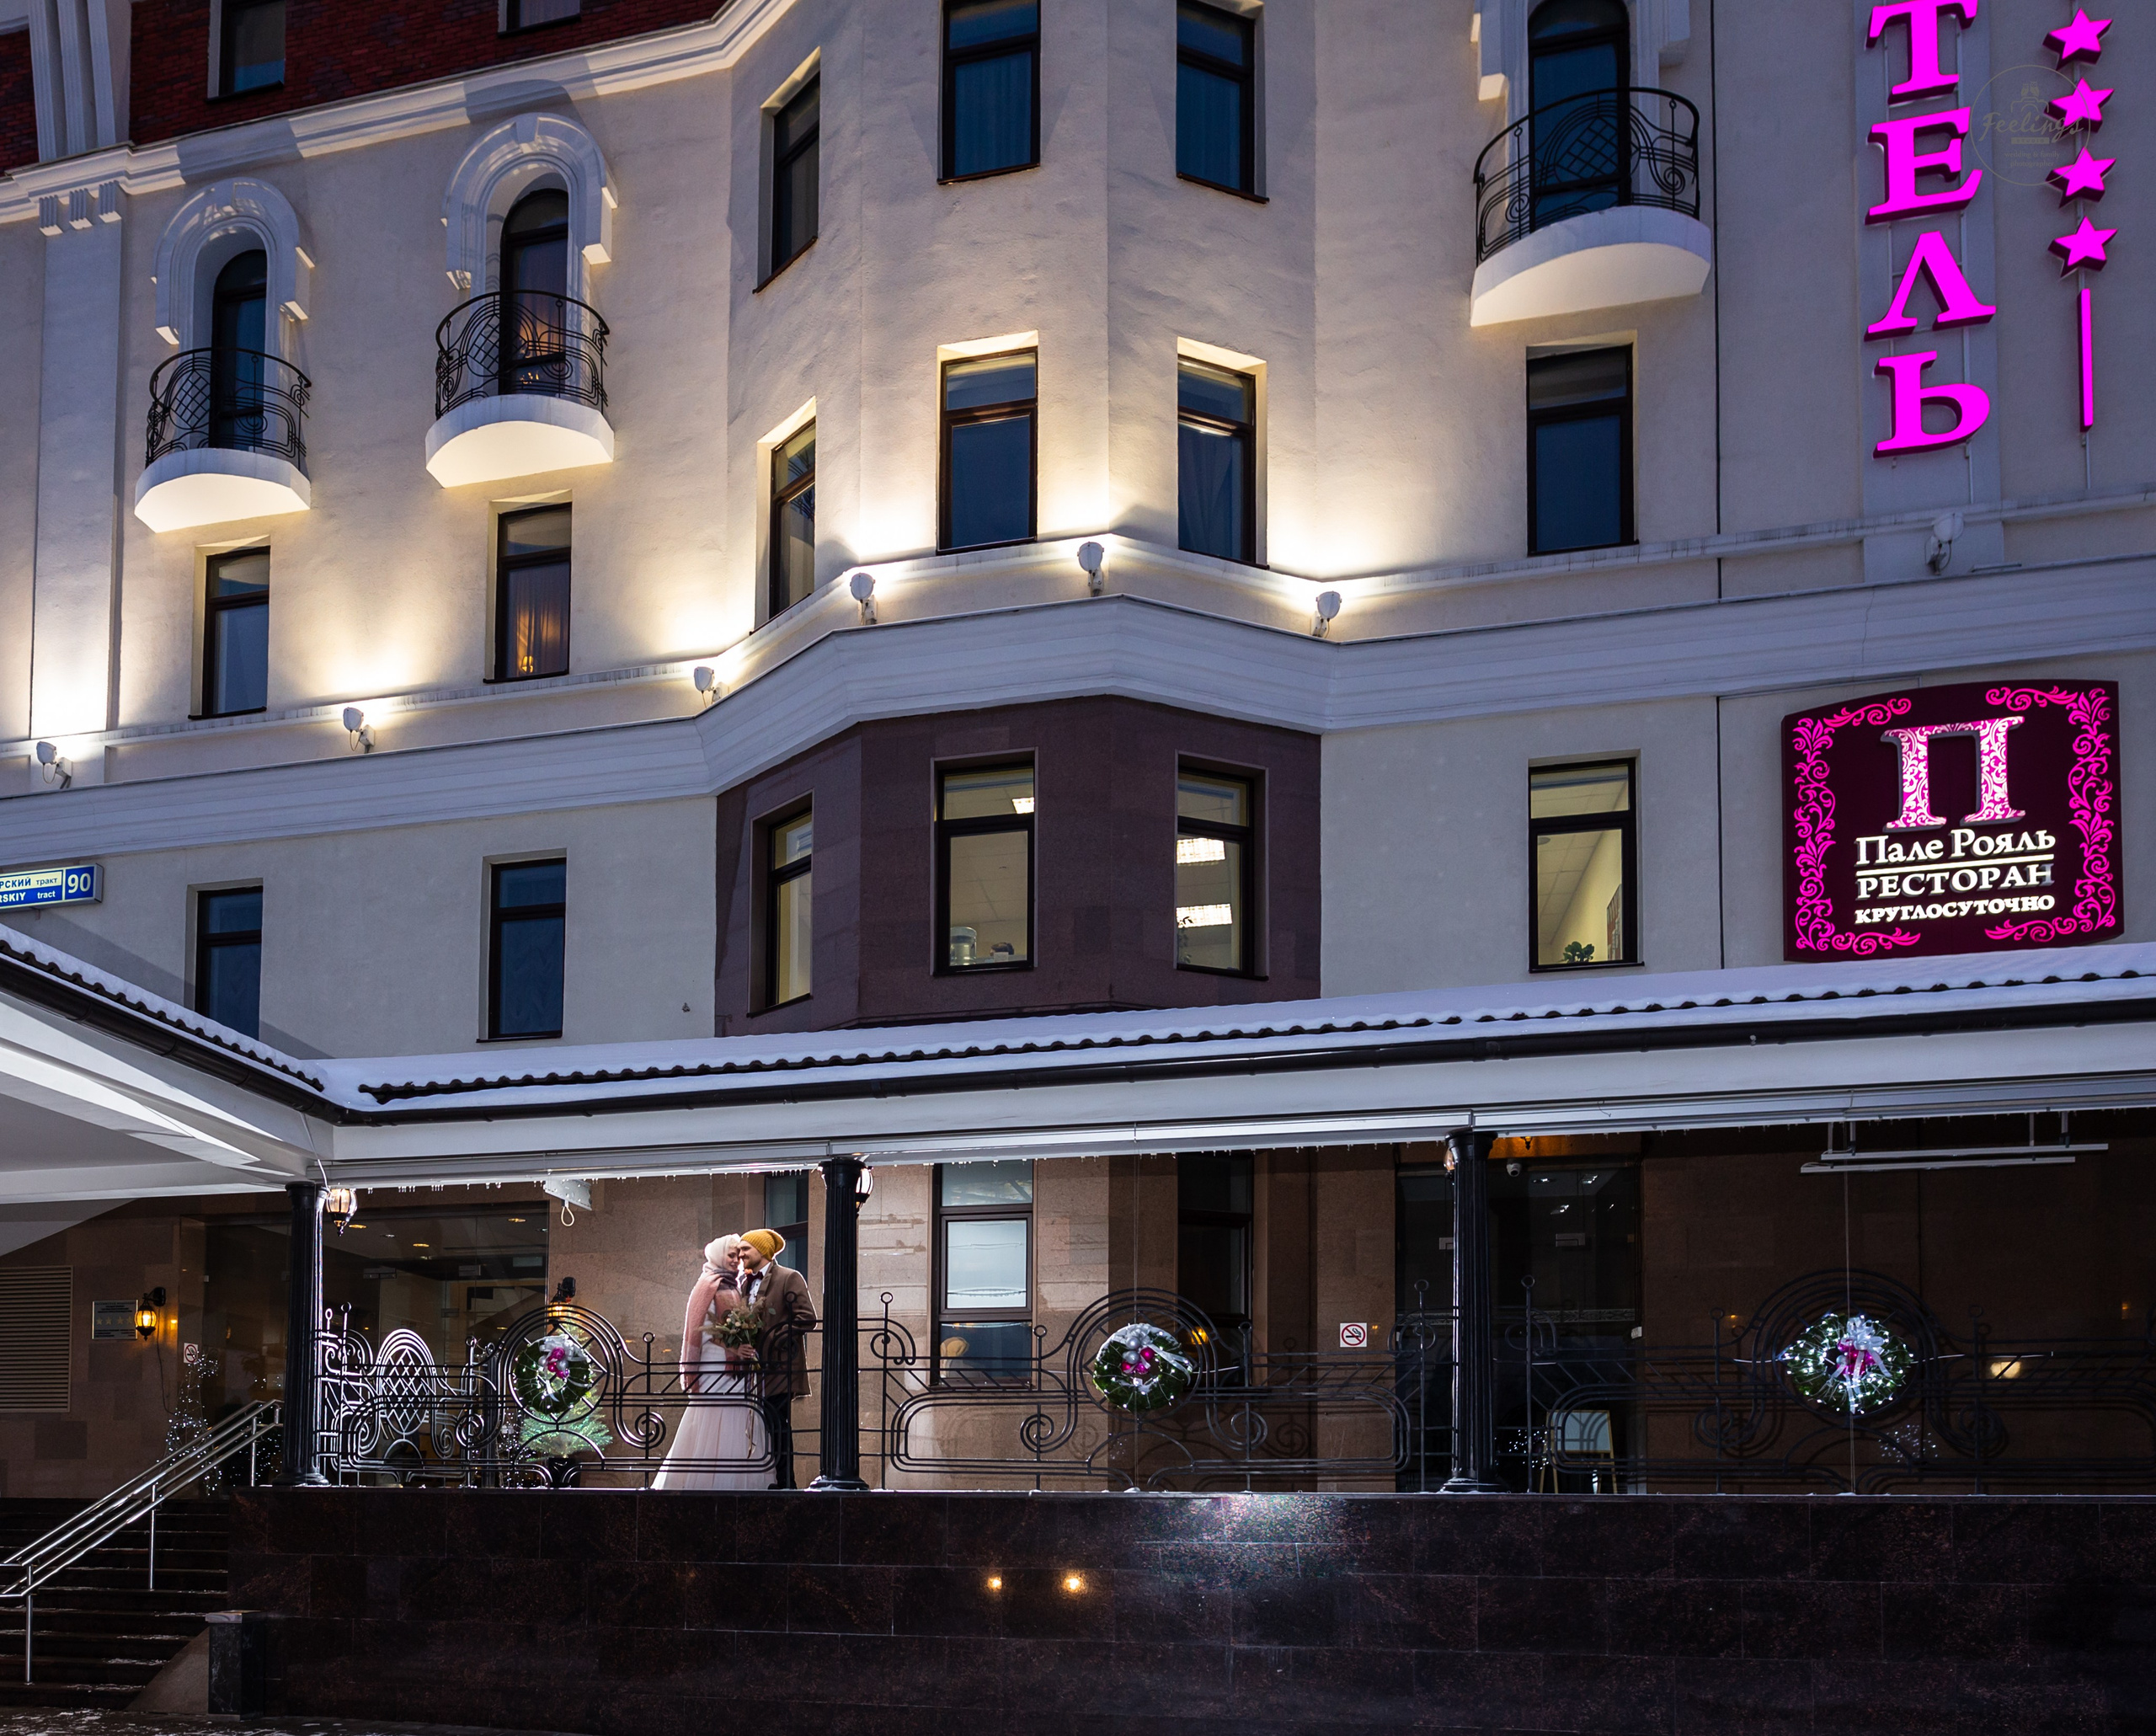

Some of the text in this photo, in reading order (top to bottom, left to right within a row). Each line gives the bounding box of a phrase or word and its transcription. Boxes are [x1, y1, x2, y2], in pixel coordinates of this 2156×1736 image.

[1855, 828, 2056, 866] Пале Рояль
[36, 878, 57, 886] тракт
[67, 873, 91, 894] 90
[1855, 863, 2055, 900] РЕСТОРАН
[37, 890, 56, 899] tract
